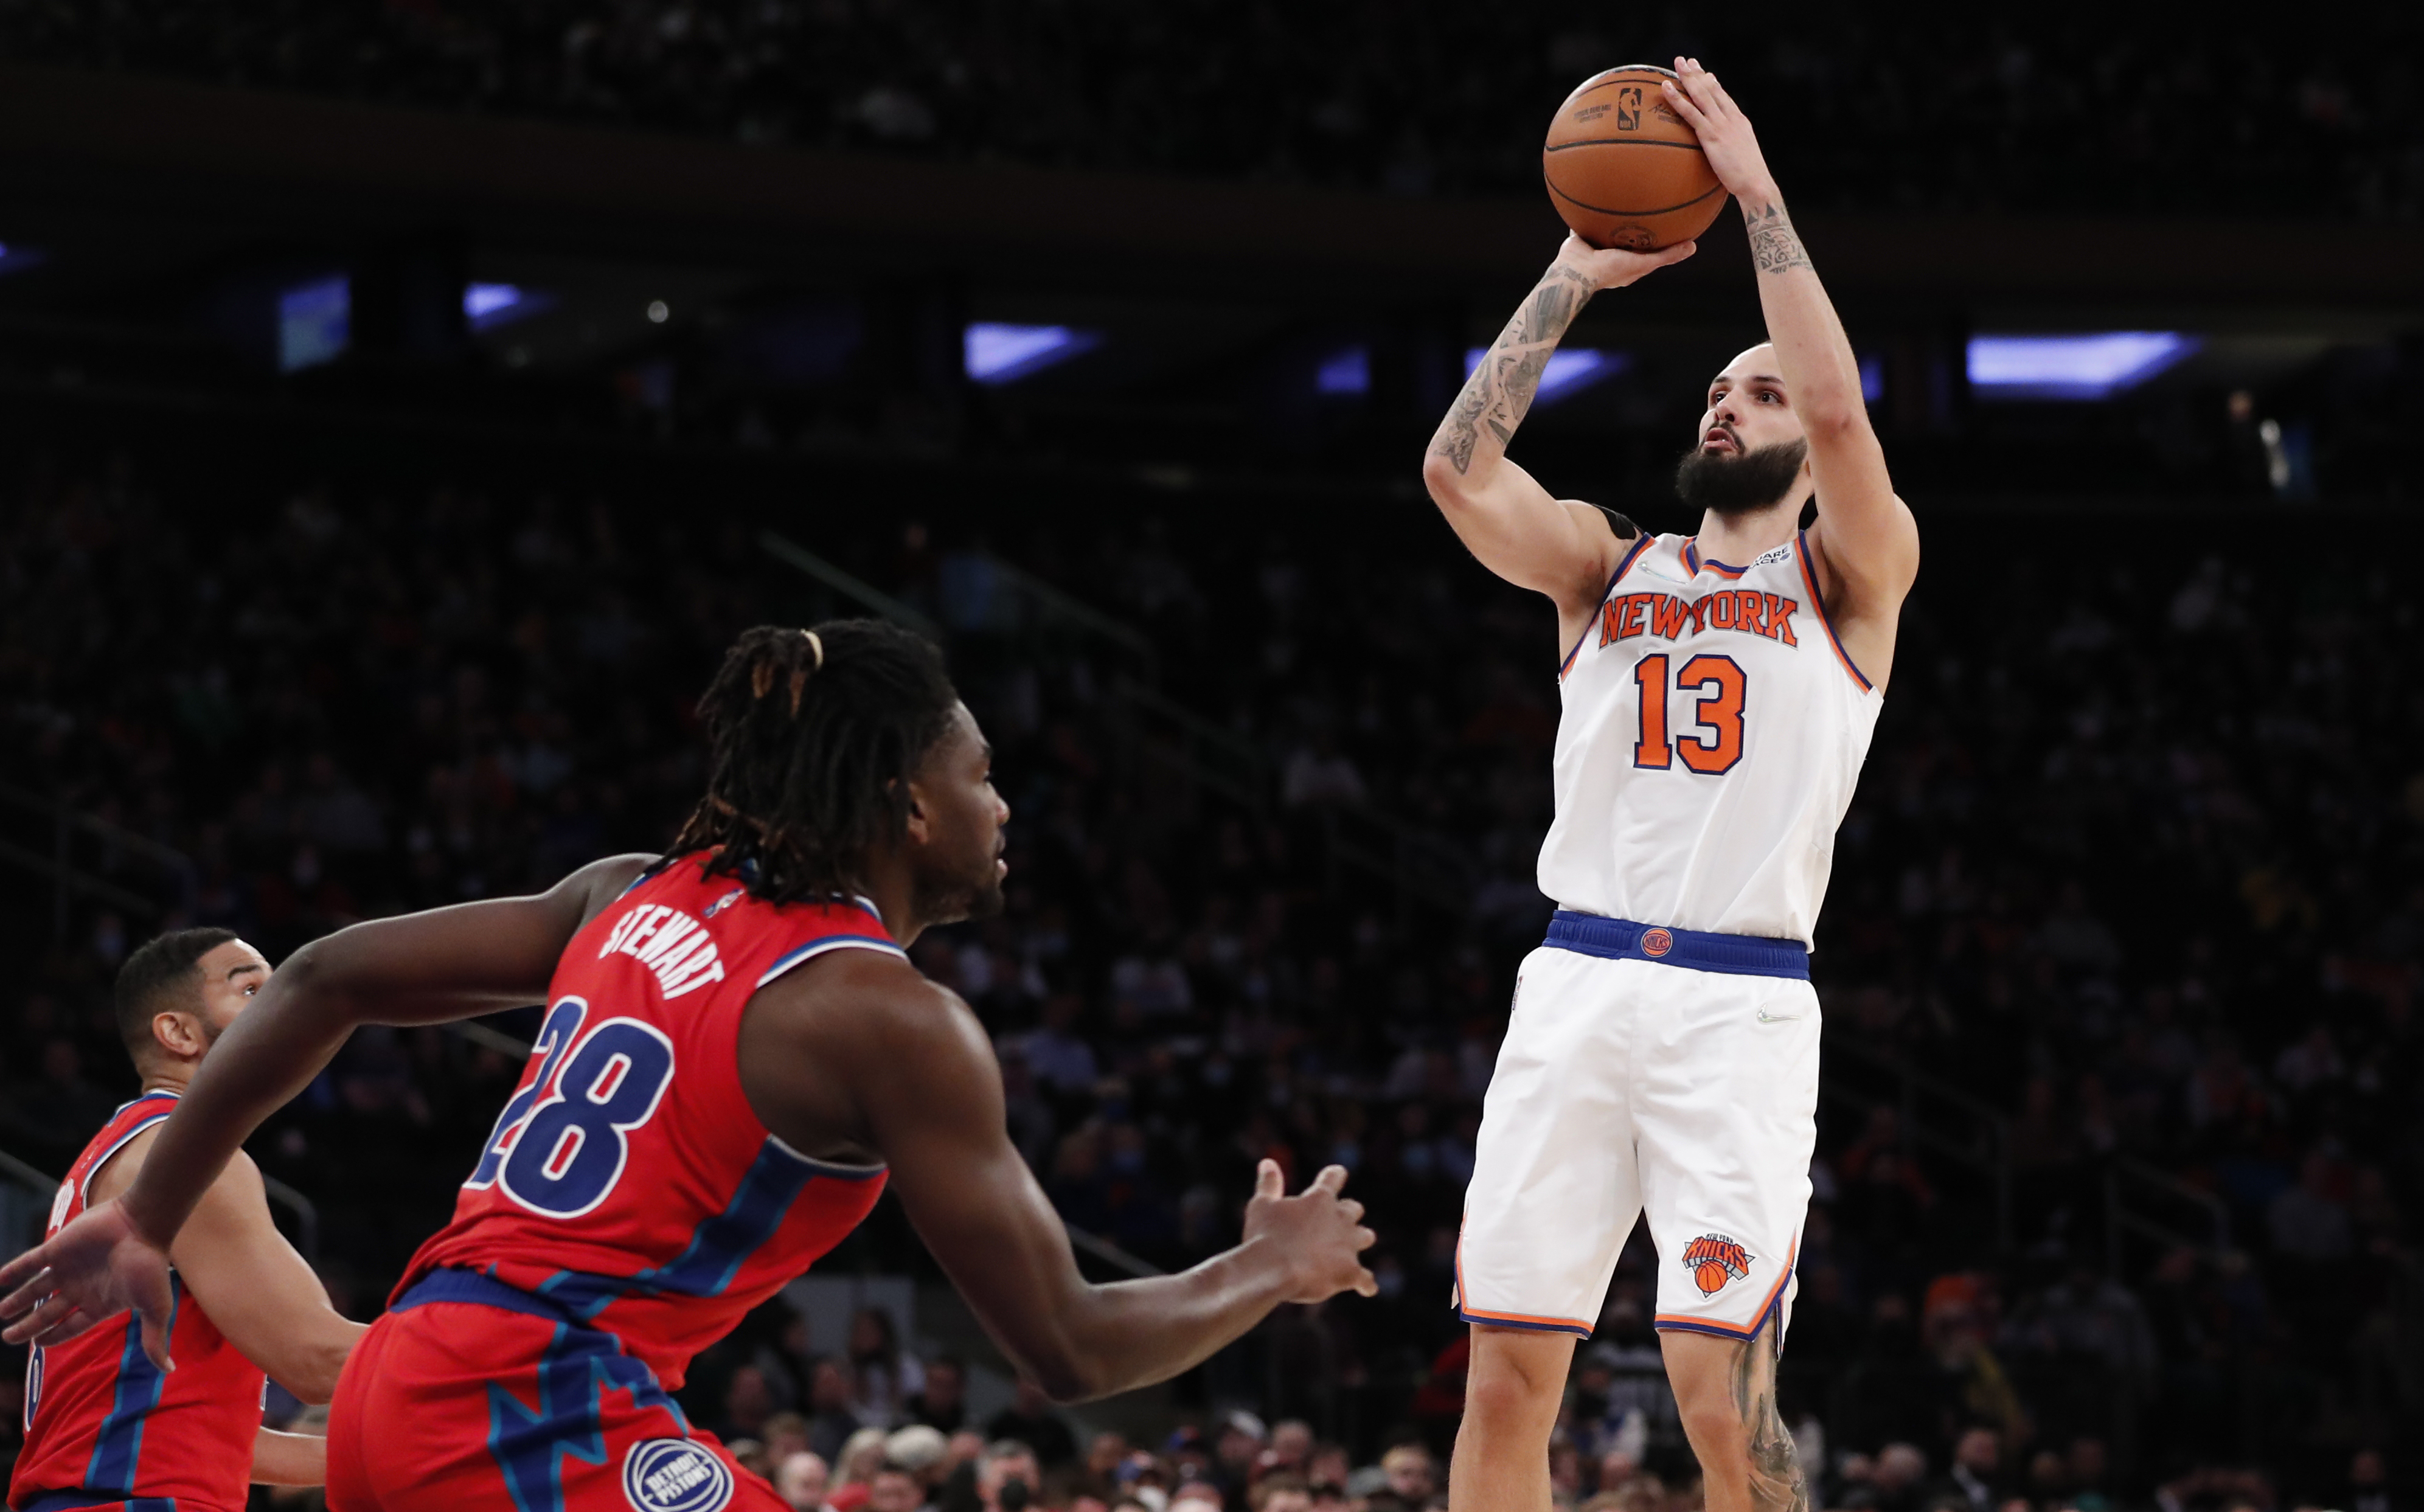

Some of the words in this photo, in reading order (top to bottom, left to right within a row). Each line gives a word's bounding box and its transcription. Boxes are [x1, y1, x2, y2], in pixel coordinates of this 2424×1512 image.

[1599, 592, 1692, 652] NEW
[1690, 589, 1799, 651] YORK
[1633, 653, 1747, 776] 13
[599, 904, 724, 1000] STEWART
[462, 995, 675, 1219] 28
[1683, 1236, 1749, 1275] KNICKS
[1719, 1234, 1734, 1245] YORK
